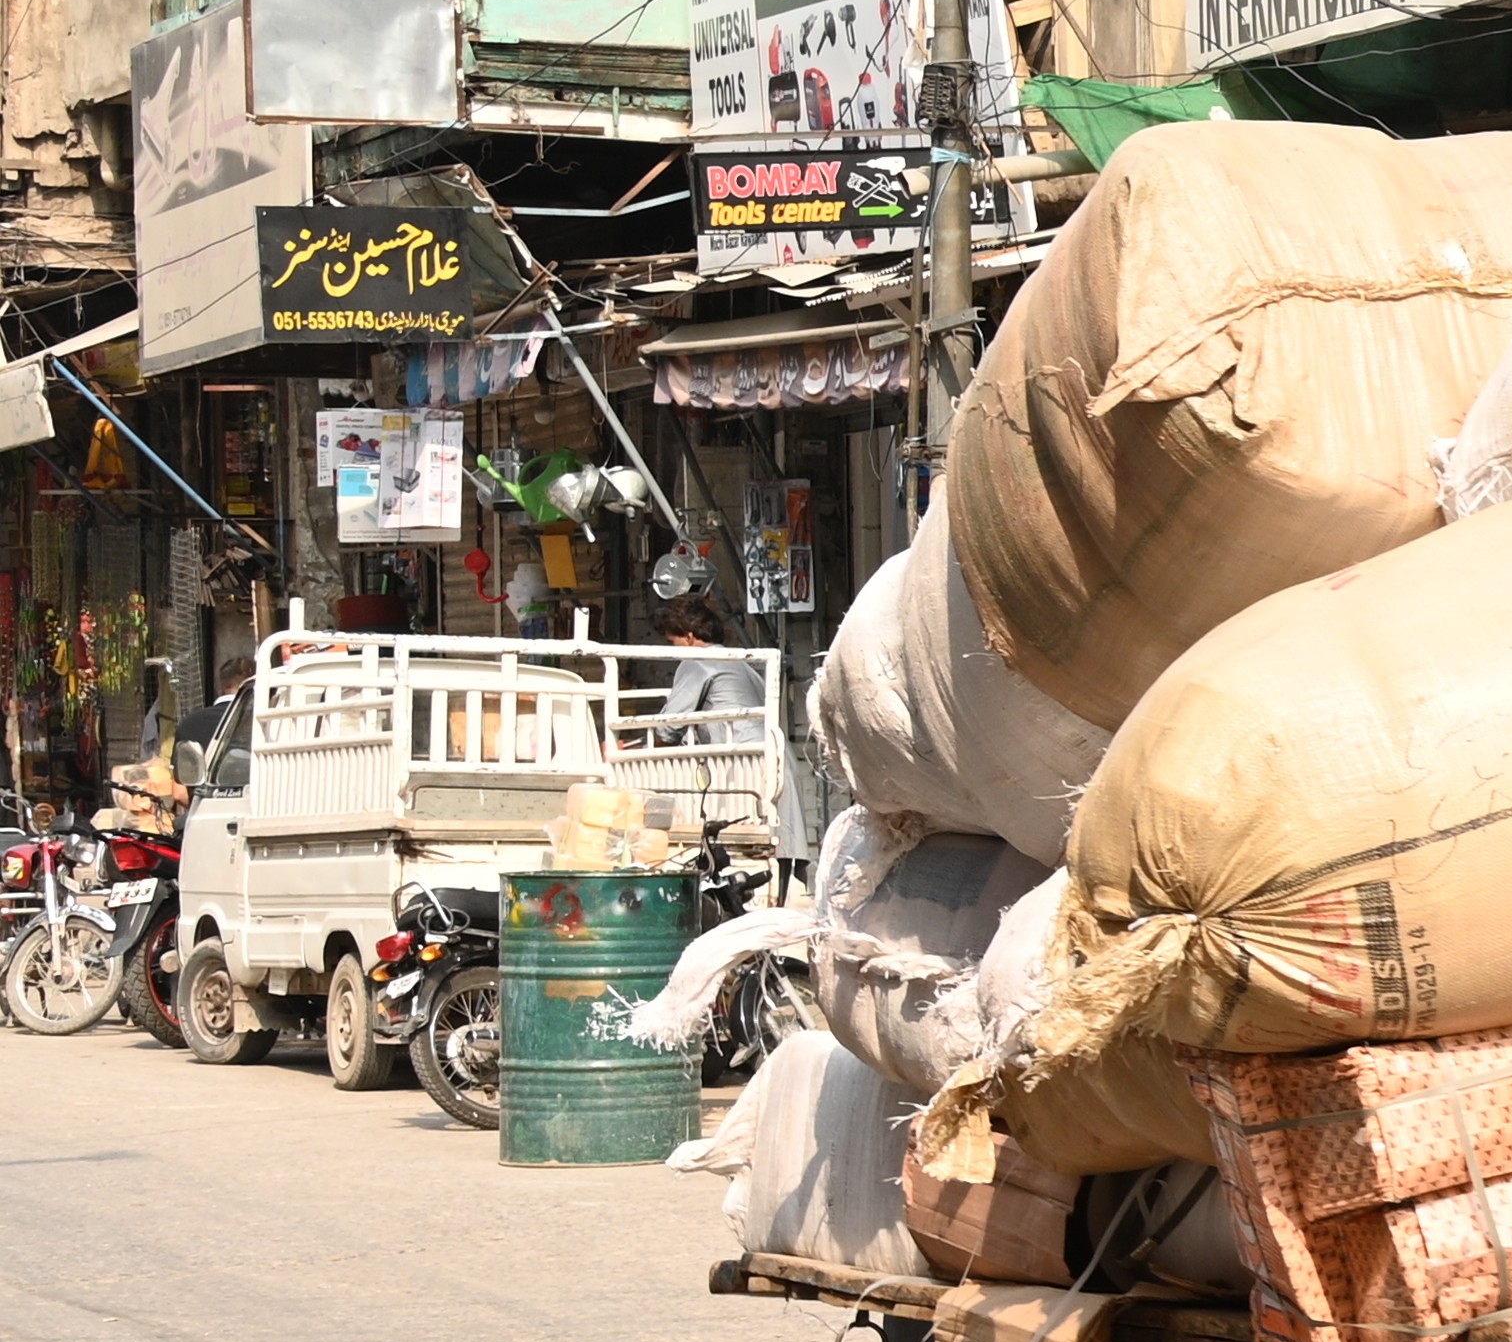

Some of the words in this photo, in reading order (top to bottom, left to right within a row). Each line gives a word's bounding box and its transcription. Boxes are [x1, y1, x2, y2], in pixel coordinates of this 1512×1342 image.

[693, 7, 756, 63] UNIVERSAL
[708, 71, 747, 120] TOOLS
[706, 161, 842, 199] BOMBAY
[709, 200, 766, 227] Tools
[773, 200, 846, 225] center
[271, 228, 329, 289] سنز
[322, 222, 422, 298] حسین
[406, 229, 460, 296] غلام
[272, 310, 374, 332] 051-5536743
[437, 310, 465, 336] موچی
